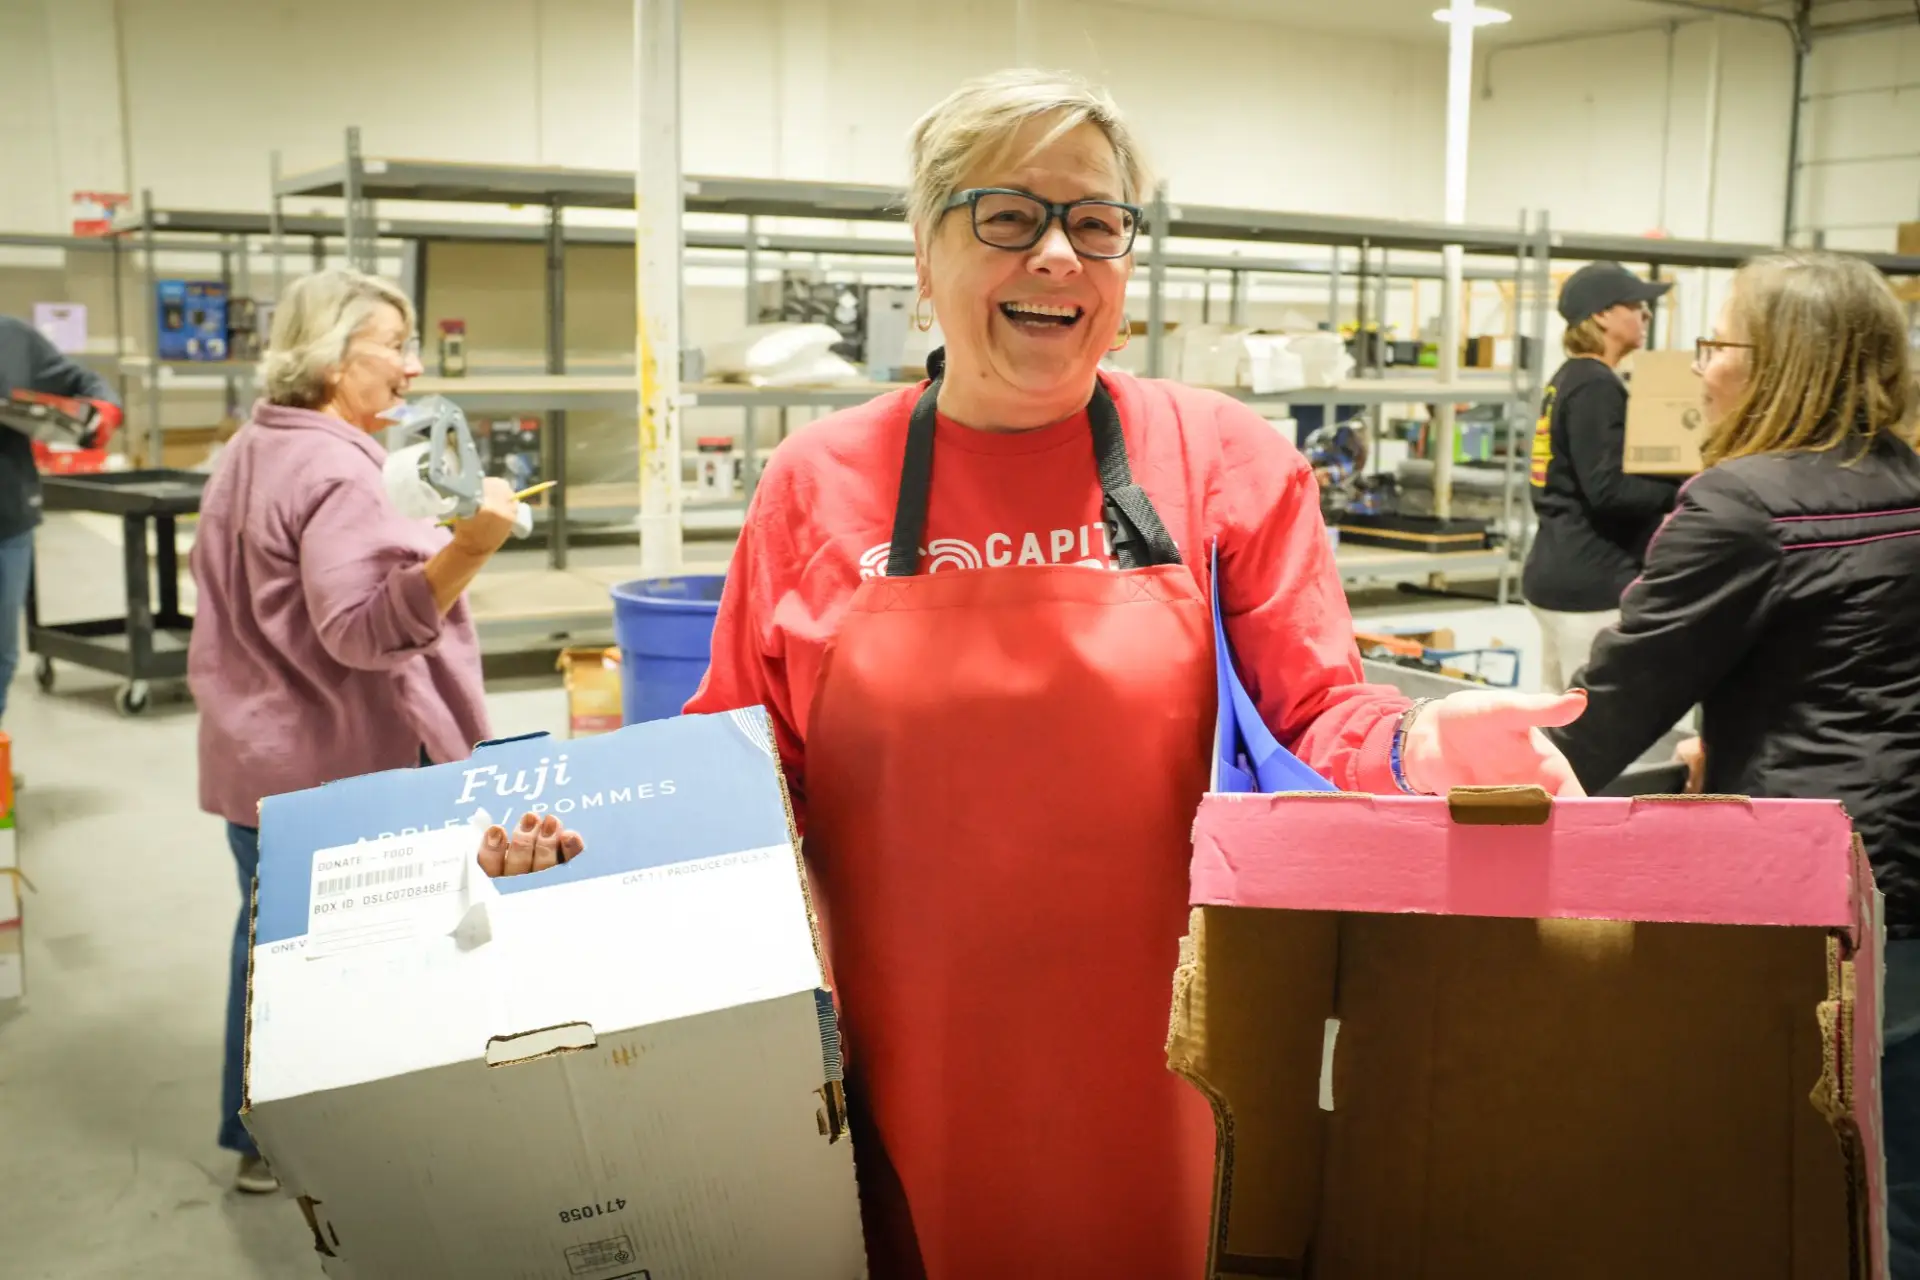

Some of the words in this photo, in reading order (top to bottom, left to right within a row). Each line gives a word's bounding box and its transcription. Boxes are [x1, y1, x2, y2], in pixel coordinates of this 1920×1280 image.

[986, 522, 1114, 566] CAPIT
[455, 754, 573, 805] Fuji
[531, 780, 677, 814] POMMES
[318, 856, 362, 871] DONATE
[383, 847, 414, 860] FOOD
[667, 859, 721, 877] PRODUCE
[723, 857, 738, 868] OF
[314, 901, 337, 914] BOX
[342, 899, 354, 909] ID
[271, 942, 296, 954] ONE
[559, 1198, 627, 1223] 471058
